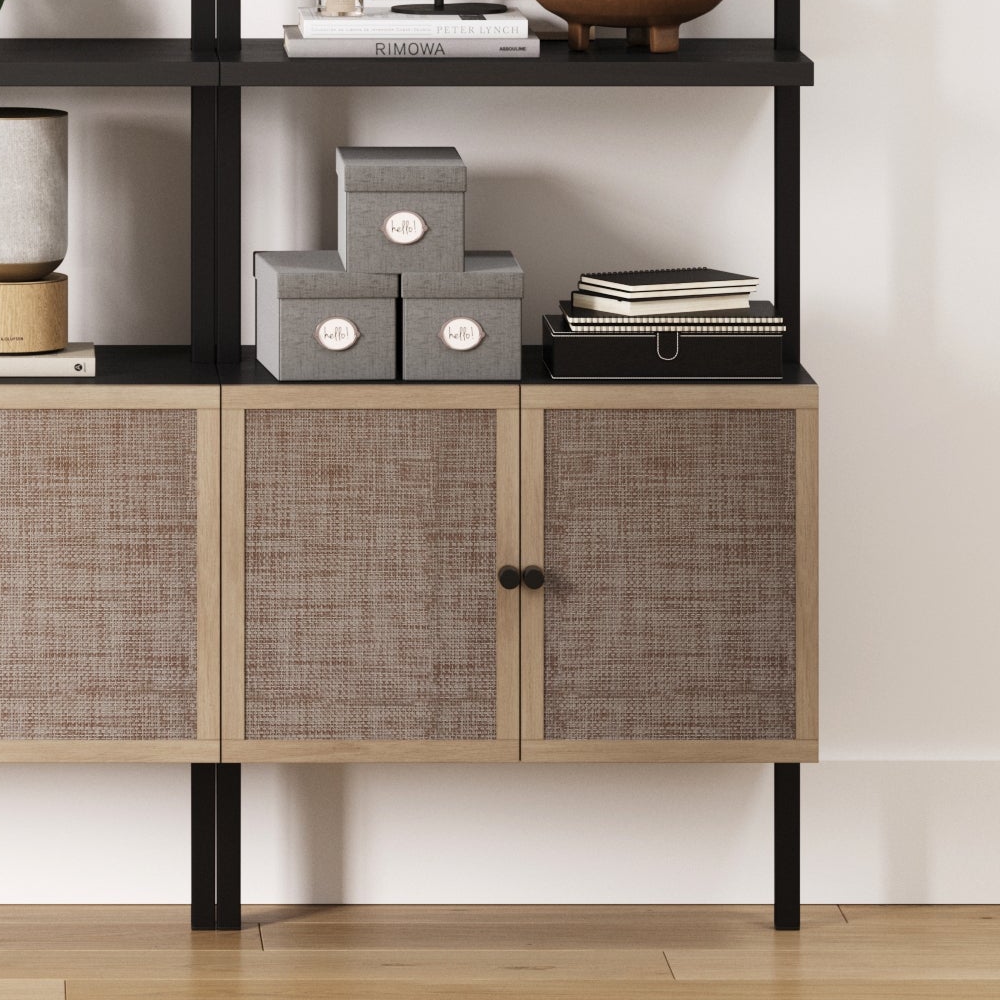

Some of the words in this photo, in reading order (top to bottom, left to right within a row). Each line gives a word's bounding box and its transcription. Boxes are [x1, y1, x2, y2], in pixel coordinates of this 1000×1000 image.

[437, 26, 475, 35] PETER
[479, 26, 520, 35] LYNCH
[375, 43, 445, 56] RIMOWA
[391, 220, 417, 235] hello!
[323, 326, 349, 341] hello!
[448, 326, 474, 341] hello!
